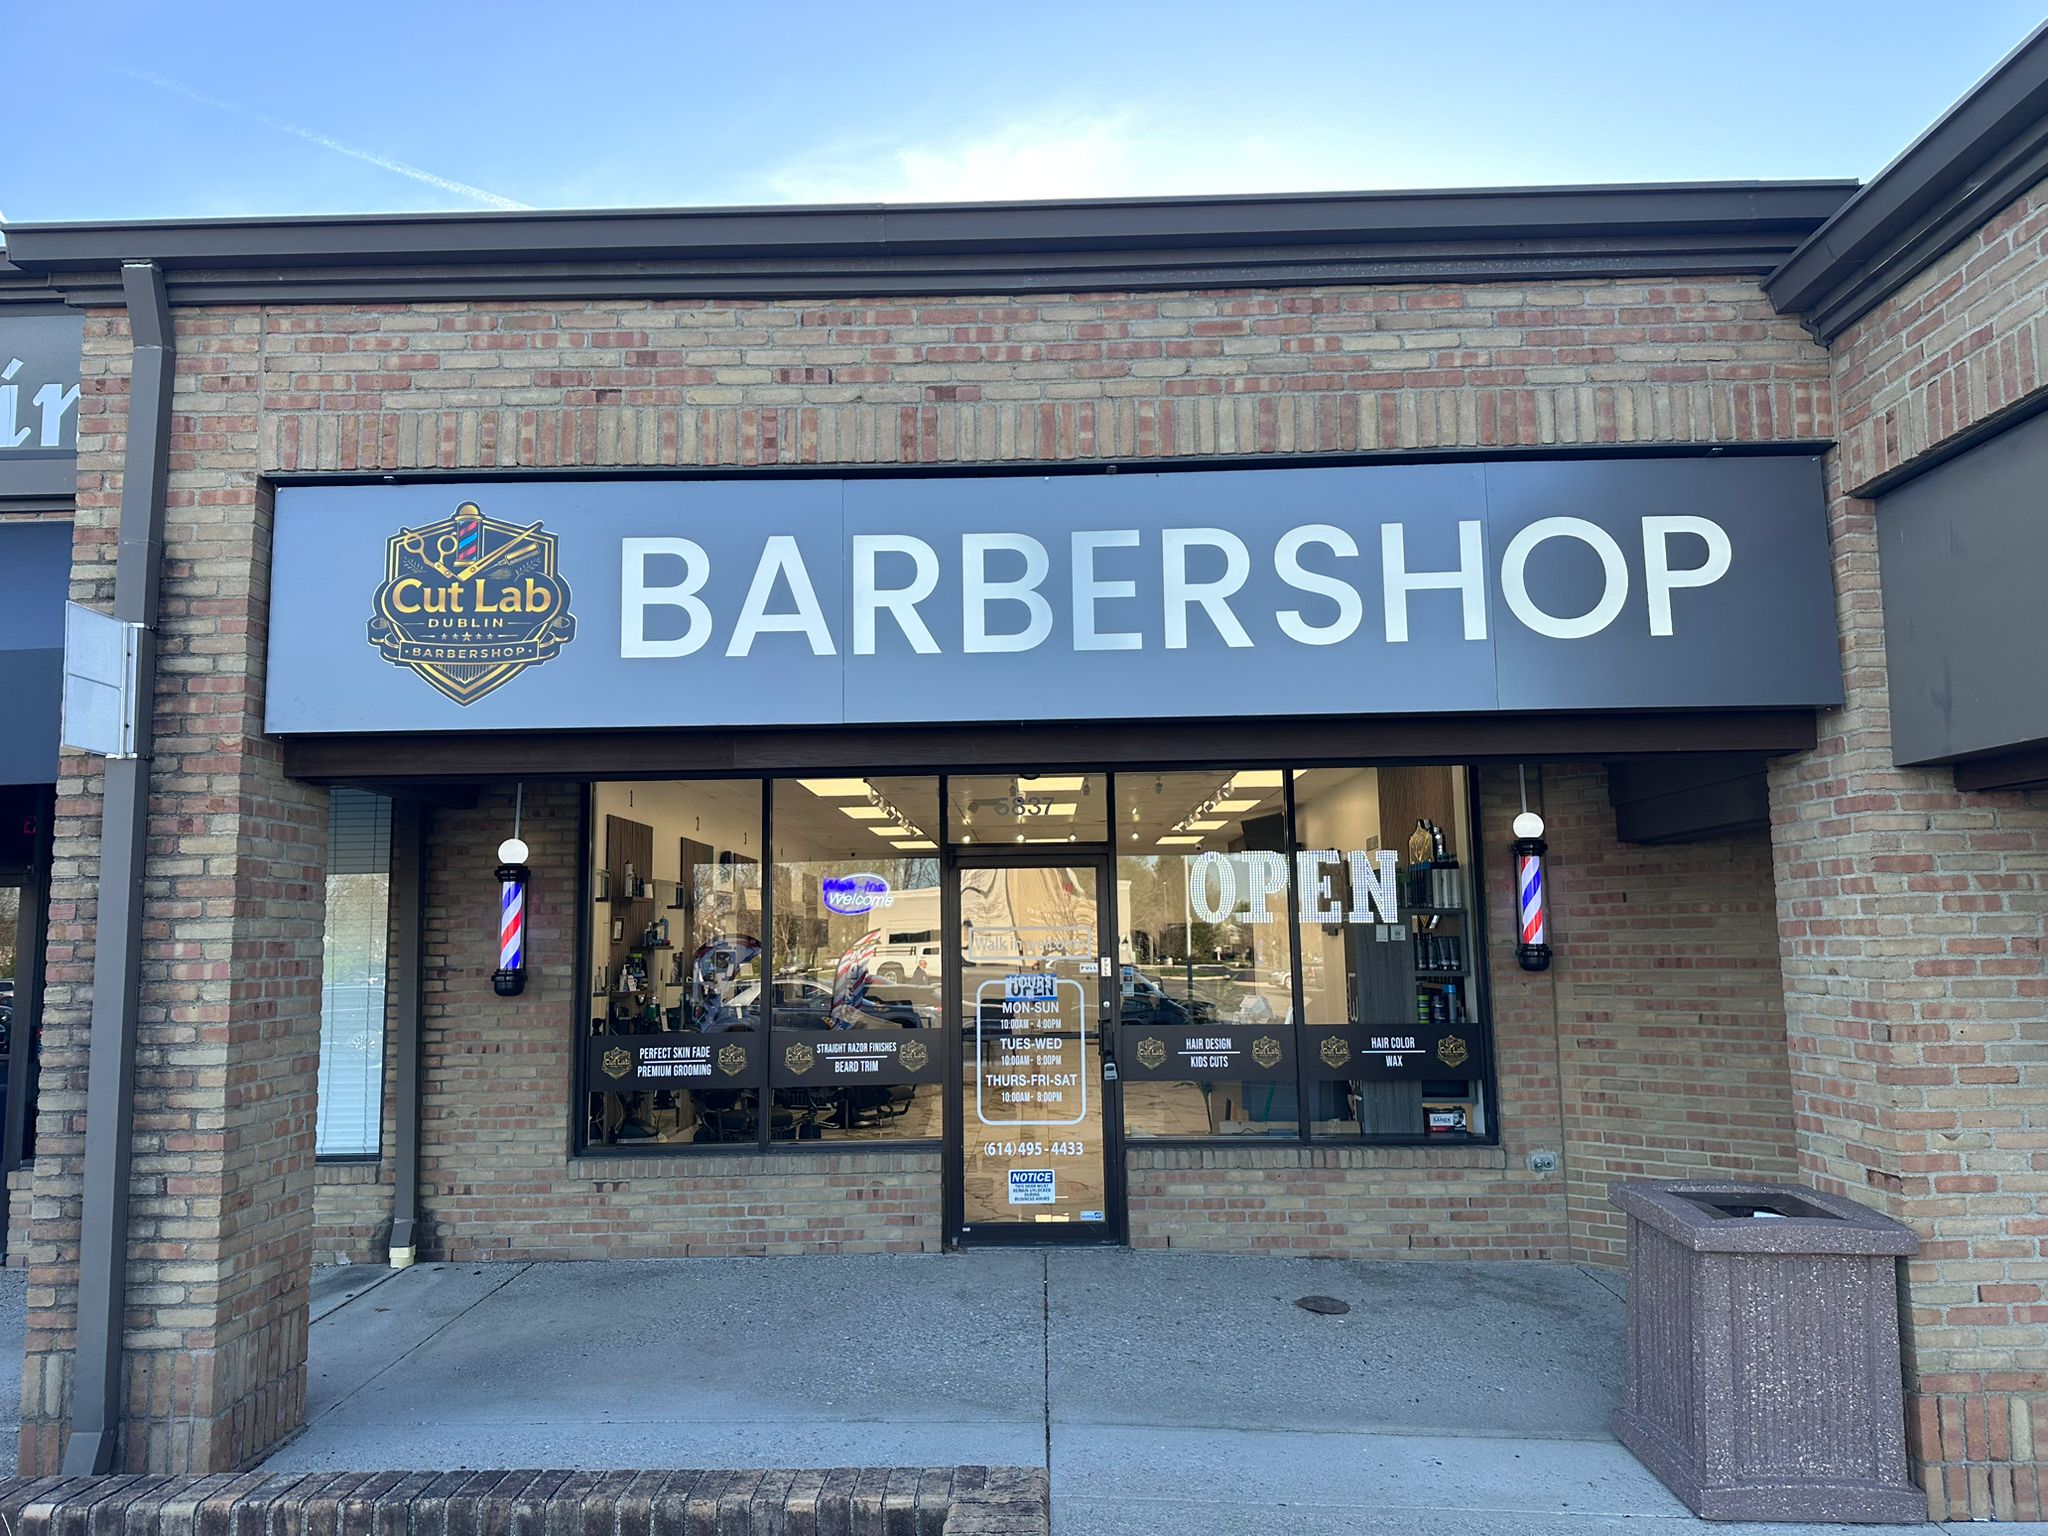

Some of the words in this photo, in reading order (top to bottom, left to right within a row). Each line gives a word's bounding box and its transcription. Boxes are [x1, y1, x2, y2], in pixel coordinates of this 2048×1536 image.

[620, 515, 1732, 659] BARBERSHOP
[392, 578, 464, 614] Cut
[474, 578, 552, 613] Lab
[428, 618, 504, 628] DUBLIN
[412, 647, 525, 659] BARBERSHOP
[1189, 849, 1398, 924] OPEN
[829, 892, 894, 906] Welcome
[975, 936, 1008, 951] Walk
[1010, 936, 1023, 951] in
[1025, 936, 1085, 951] welco
[1009, 975, 1052, 988] HOURS
[1002, 1001, 1060, 1014] MON-SUN
[1036, 1018, 1062, 1029] 4:00PM
[816, 1043, 846, 1054] STRAIGHT
[847, 1043, 868, 1053] RAZOR
[869, 1042, 897, 1053] FINISHES
[1000, 1037, 1063, 1050] TUES-WED
[1186, 1038, 1204, 1050] HAIR
[1205, 1038, 1231, 1050] DESIGN
[1371, 1037, 1389, 1048] HAIR
[1391, 1037, 1415, 1048] COLOR
[639, 1047, 672, 1059] PERFECT
[673, 1047, 691, 1058] SKIN
[692, 1046, 711, 1058] FADE
[835, 1061, 859, 1073] BEARD
[860, 1060, 879, 1072] TRIM
[1036, 1055, 1062, 1066] 8:00PM
[1190, 1056, 1208, 1068] KIDS
[1209, 1056, 1229, 1068] CUTS
[1385, 1055, 1403, 1067] WAX
[637, 1065, 672, 1078] PREMIUM
[673, 1064, 712, 1077] GROOMING
[985, 1073, 1078, 1086] THURS-FRI-SAT
[1036, 1091, 1063, 1102] 8:00PM
[1011, 1172, 1052, 1182] NOTICE
